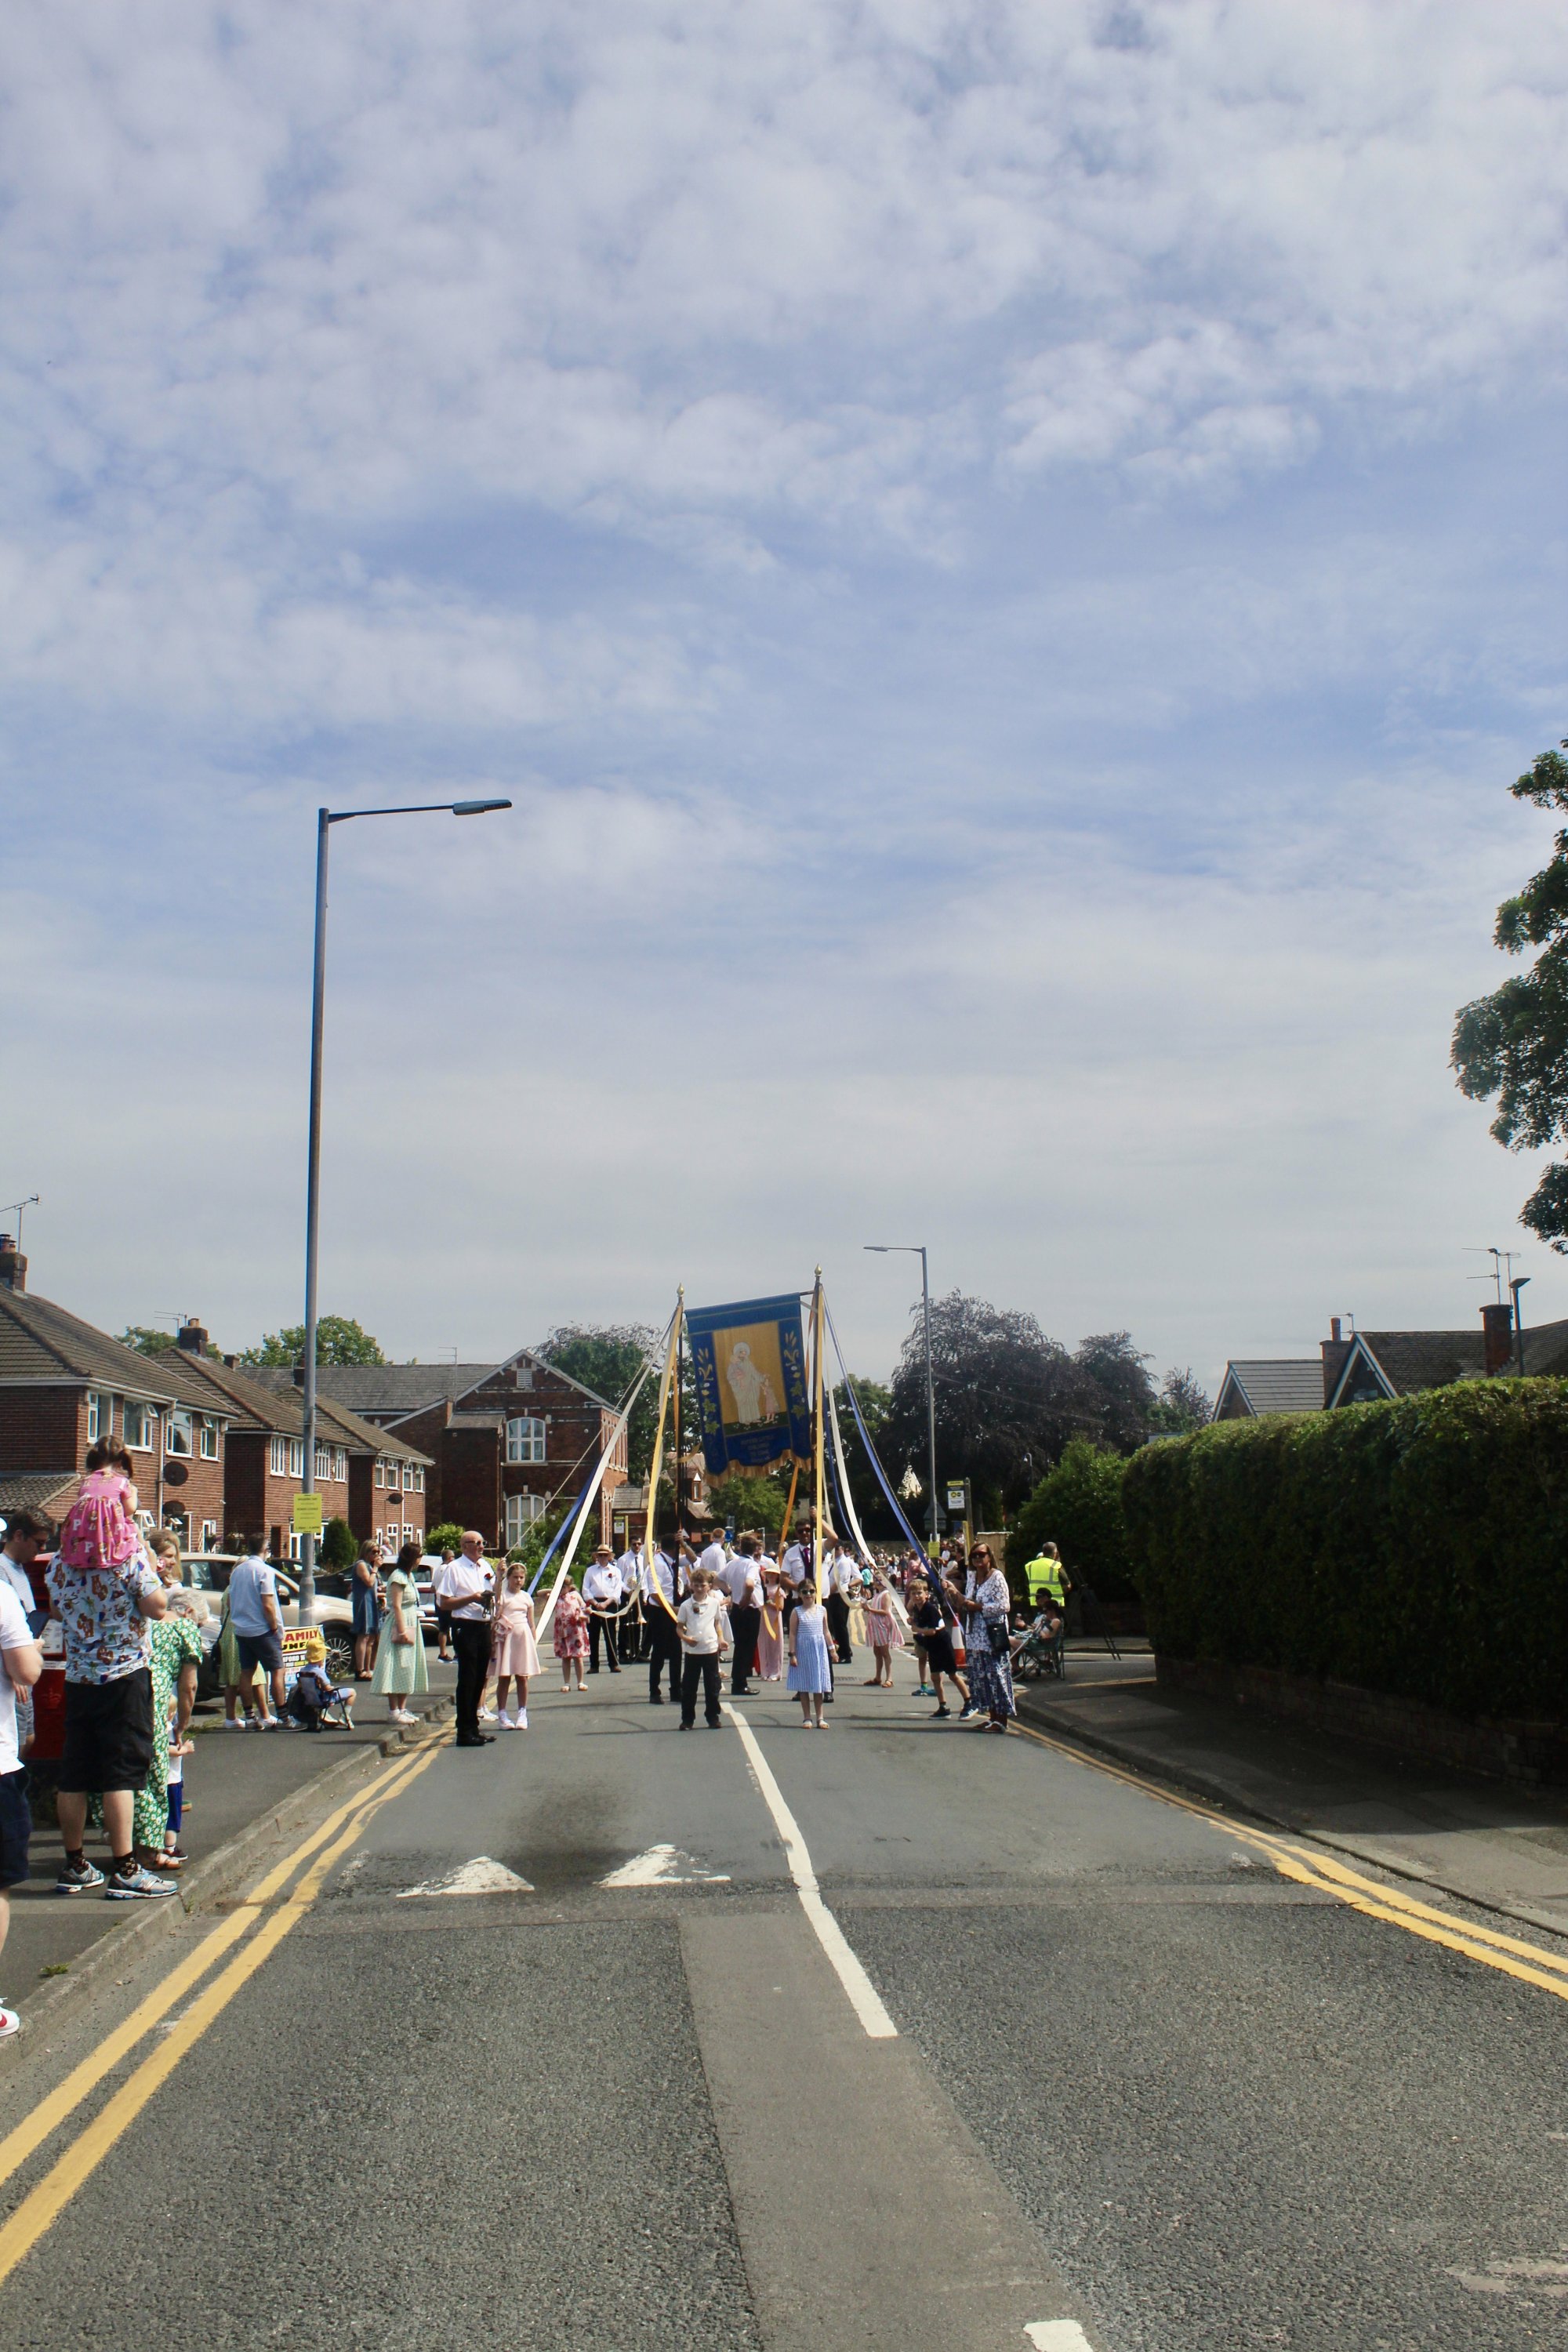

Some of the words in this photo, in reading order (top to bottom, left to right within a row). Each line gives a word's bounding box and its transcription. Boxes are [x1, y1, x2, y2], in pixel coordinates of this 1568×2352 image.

[73, 1519, 81, 1530] P
[85, 1541, 93, 1552] P
[285, 1630, 318, 1642] AMILY
